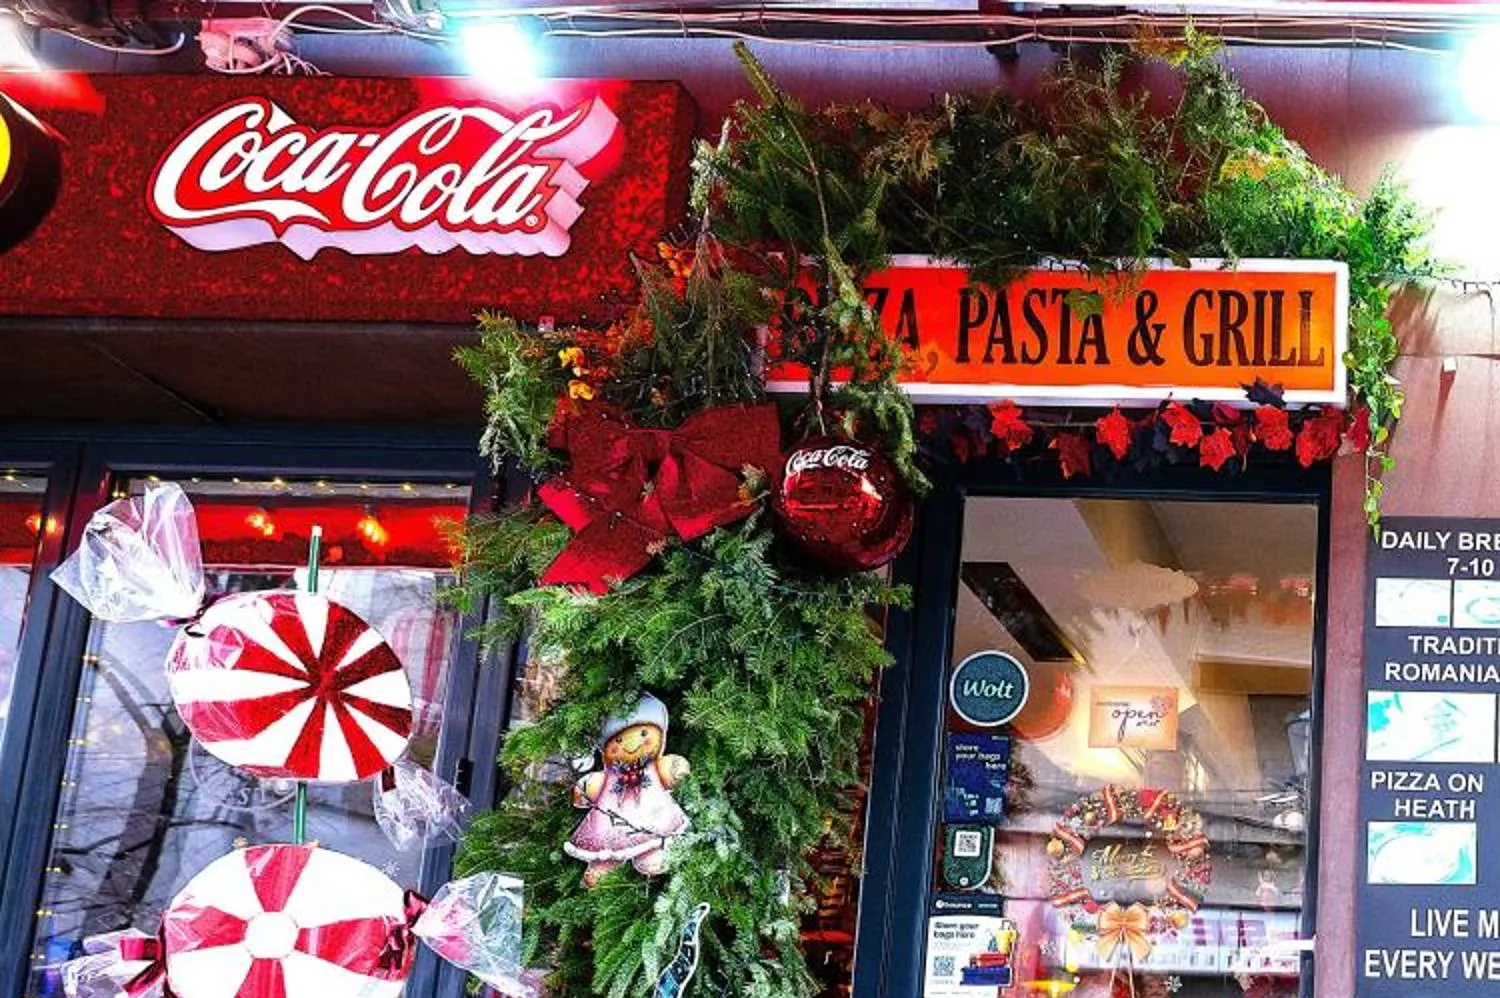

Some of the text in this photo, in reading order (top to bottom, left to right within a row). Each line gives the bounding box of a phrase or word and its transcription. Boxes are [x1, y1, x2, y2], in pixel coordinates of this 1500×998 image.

[153, 98, 584, 228] Coca-Cola
[956, 288, 1109, 366] PASTA
[1128, 289, 1166, 367] &
[1183, 288, 1326, 368] GRILL
[1381, 531, 1450, 550] DAILY
[1447, 557, 1494, 576] 7-10
[963, 679, 1015, 699] Wolt
[1371, 771, 1484, 793] PIZZA ON
[1394, 798, 1475, 820] HEATH
[1410, 908, 1469, 938] LIVE
[1364, 949, 1454, 979] EVERY
